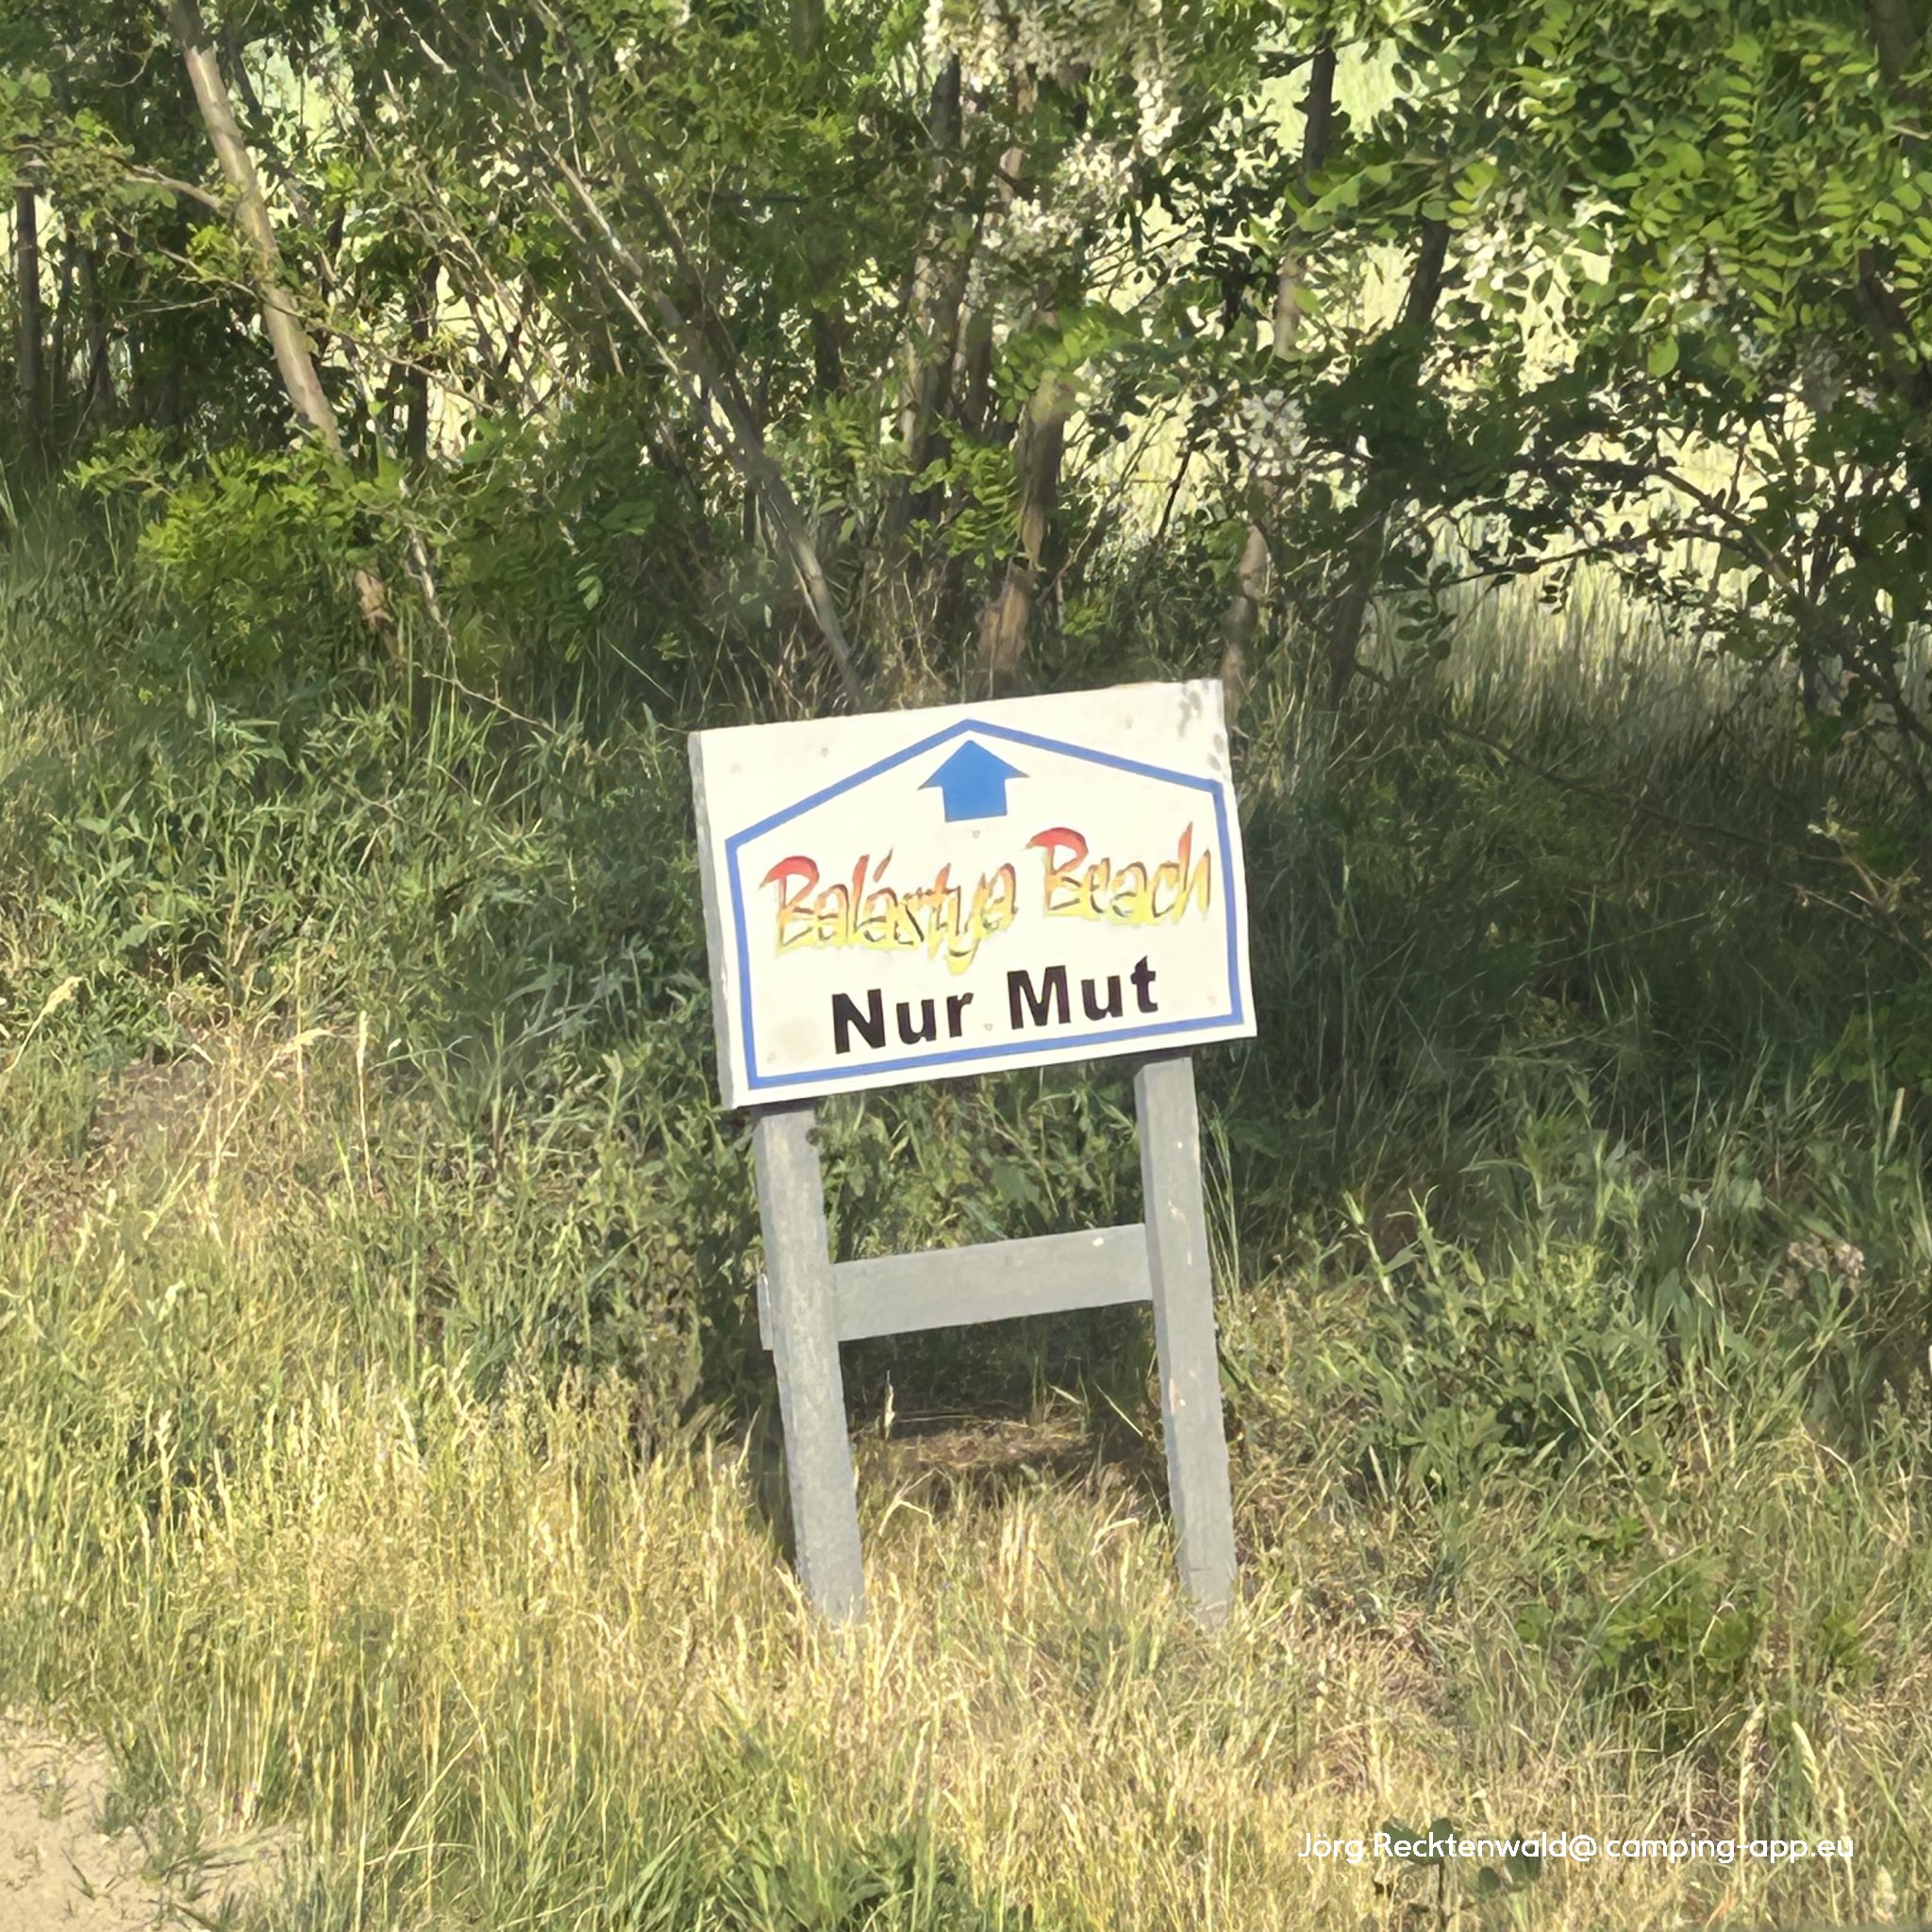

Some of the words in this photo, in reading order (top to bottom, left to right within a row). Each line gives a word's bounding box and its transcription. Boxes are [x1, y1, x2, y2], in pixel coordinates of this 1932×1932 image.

[1025, 822, 1210, 926] Beach
[832, 989, 974, 1054] Nur
[1007, 956, 1158, 1030] Mut
